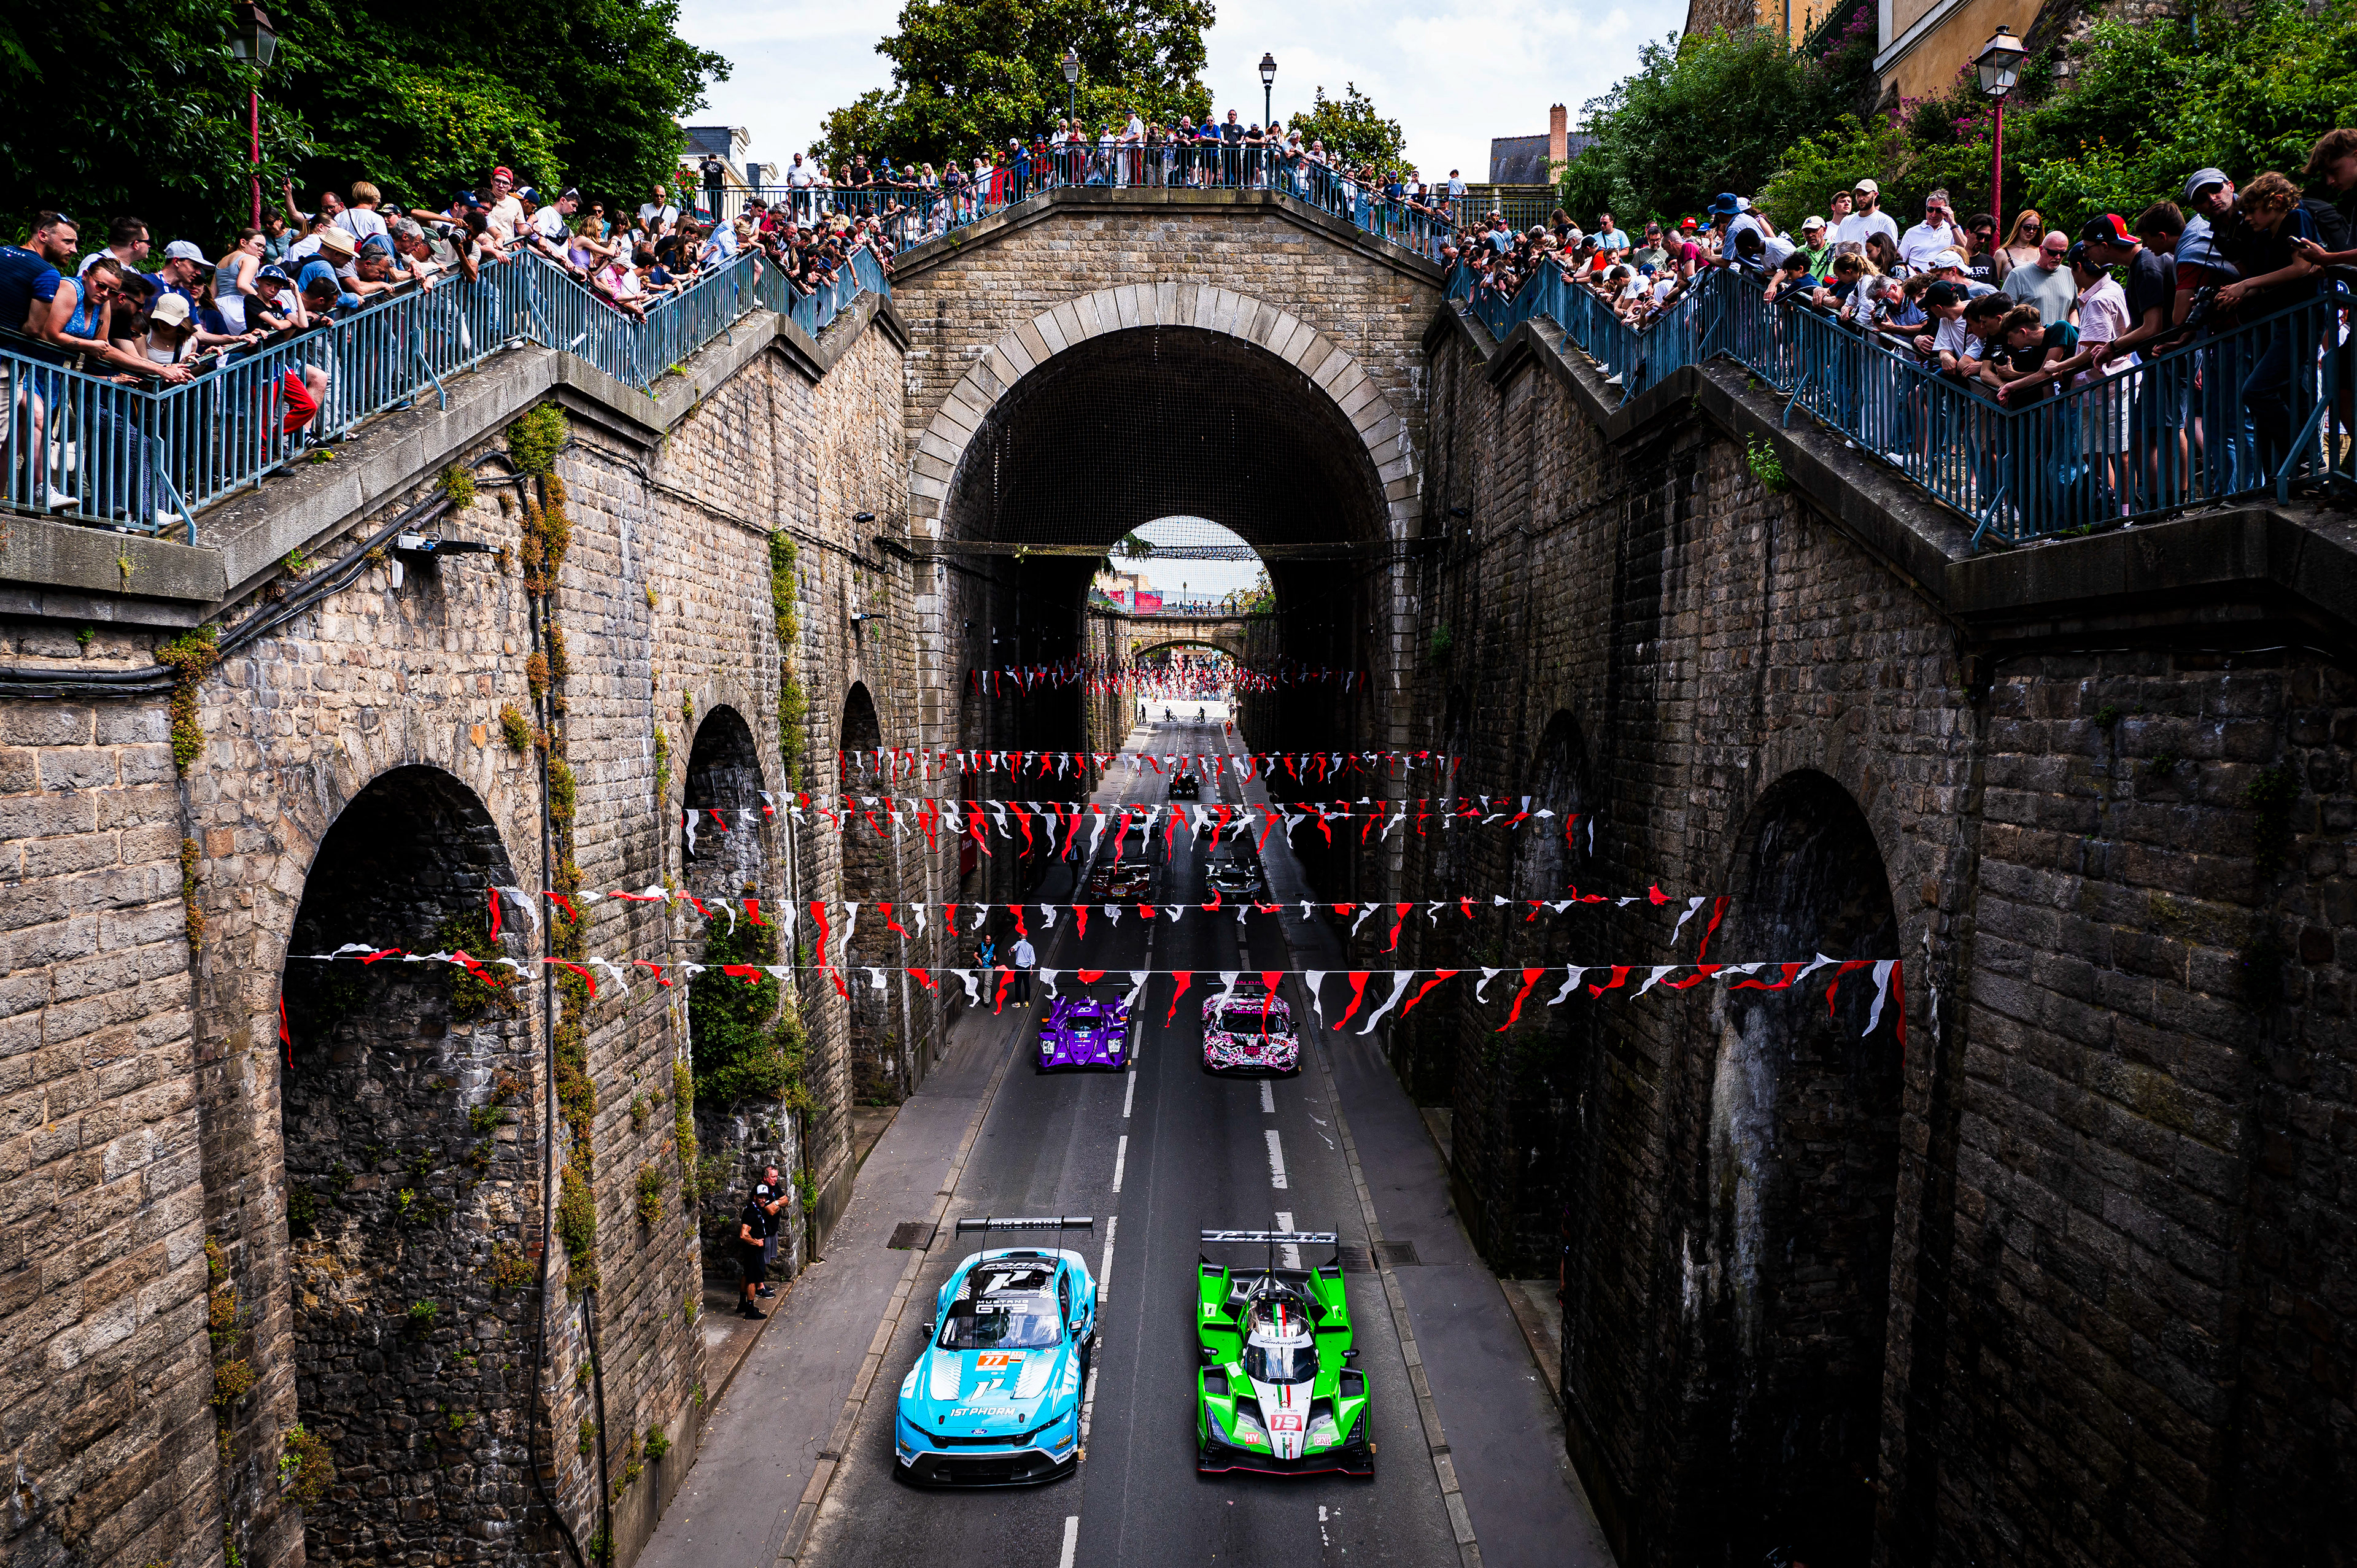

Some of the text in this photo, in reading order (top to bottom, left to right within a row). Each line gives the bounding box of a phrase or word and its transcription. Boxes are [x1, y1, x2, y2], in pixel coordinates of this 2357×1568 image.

[975, 1303, 1029, 1314] GT3
[983, 1356, 1004, 1365] 77
[950, 1407, 1016, 1416] 1ST PHORM
[1274, 1416, 1299, 1429] 19
[1245, 1434, 1258, 1442] HY
